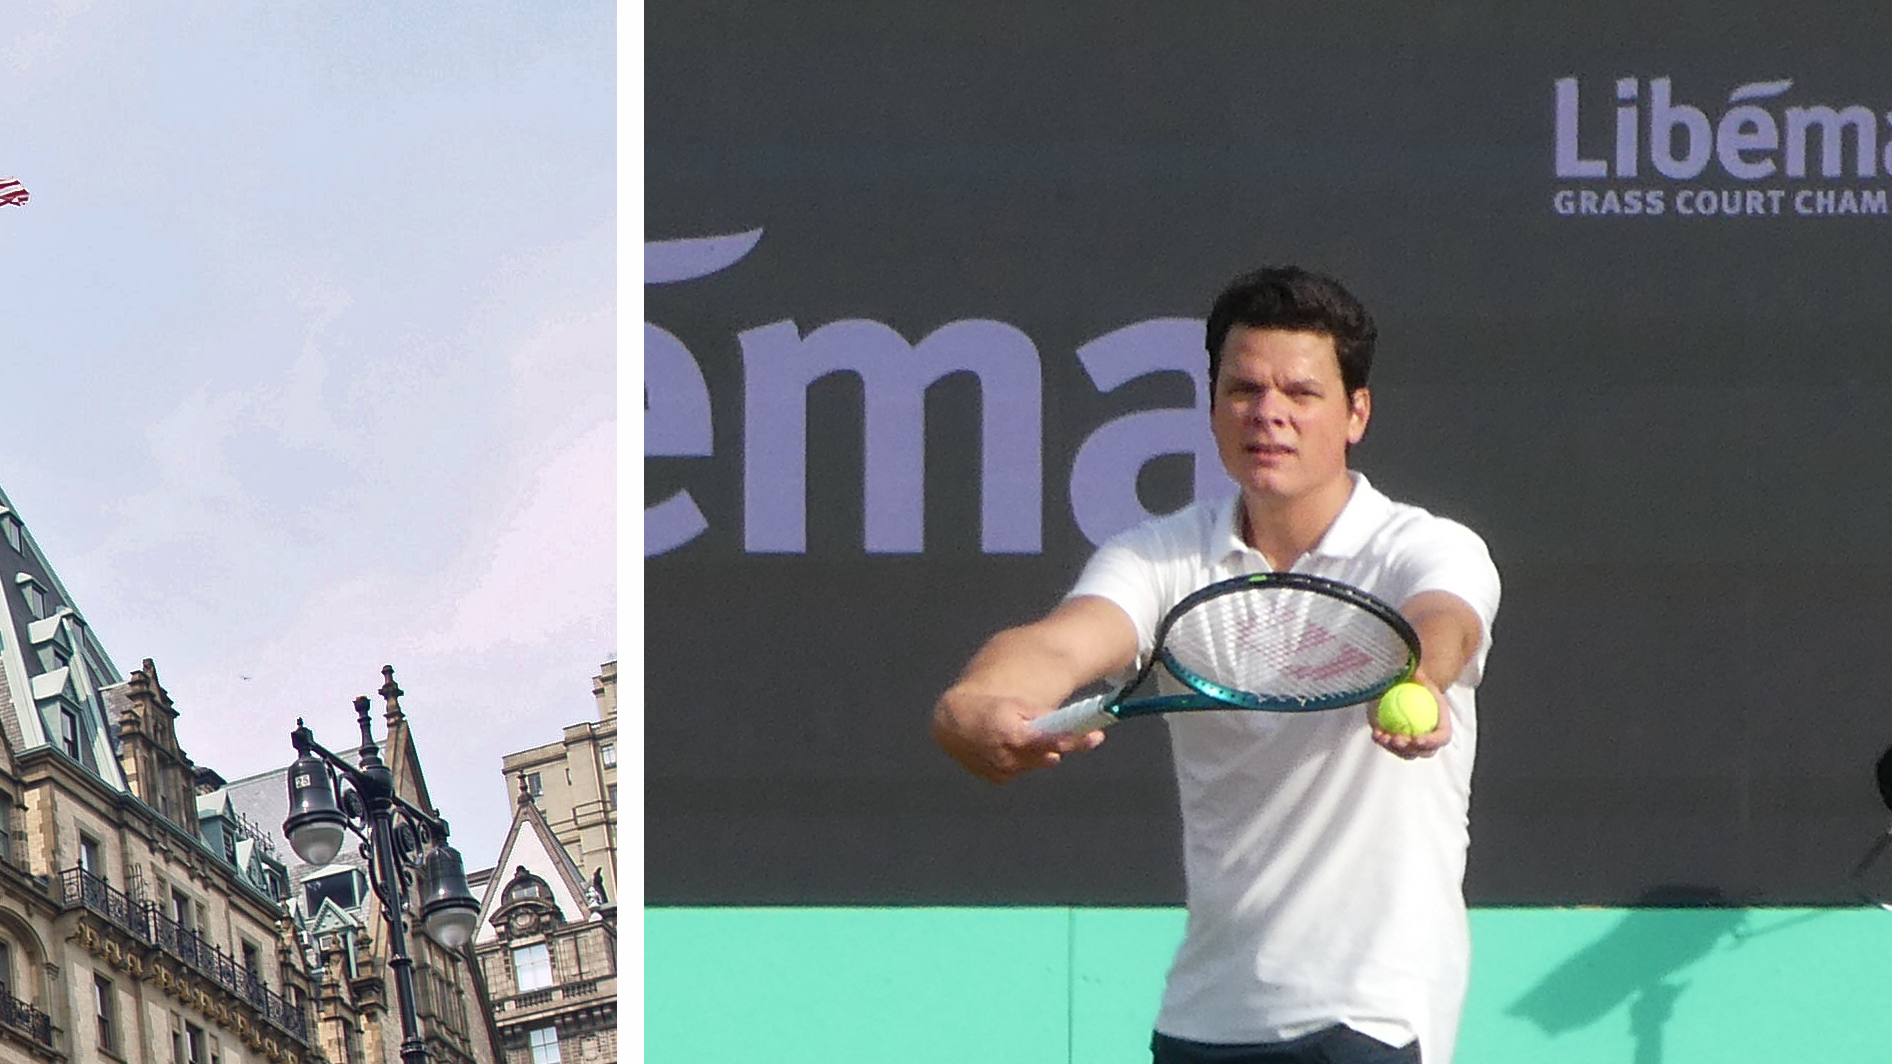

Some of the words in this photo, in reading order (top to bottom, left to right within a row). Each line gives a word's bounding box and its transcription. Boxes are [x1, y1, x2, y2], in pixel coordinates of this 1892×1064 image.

[1555, 76, 1892, 180] Libém
[1554, 190, 1665, 215] GRASS
[1675, 190, 1785, 215] COURT
